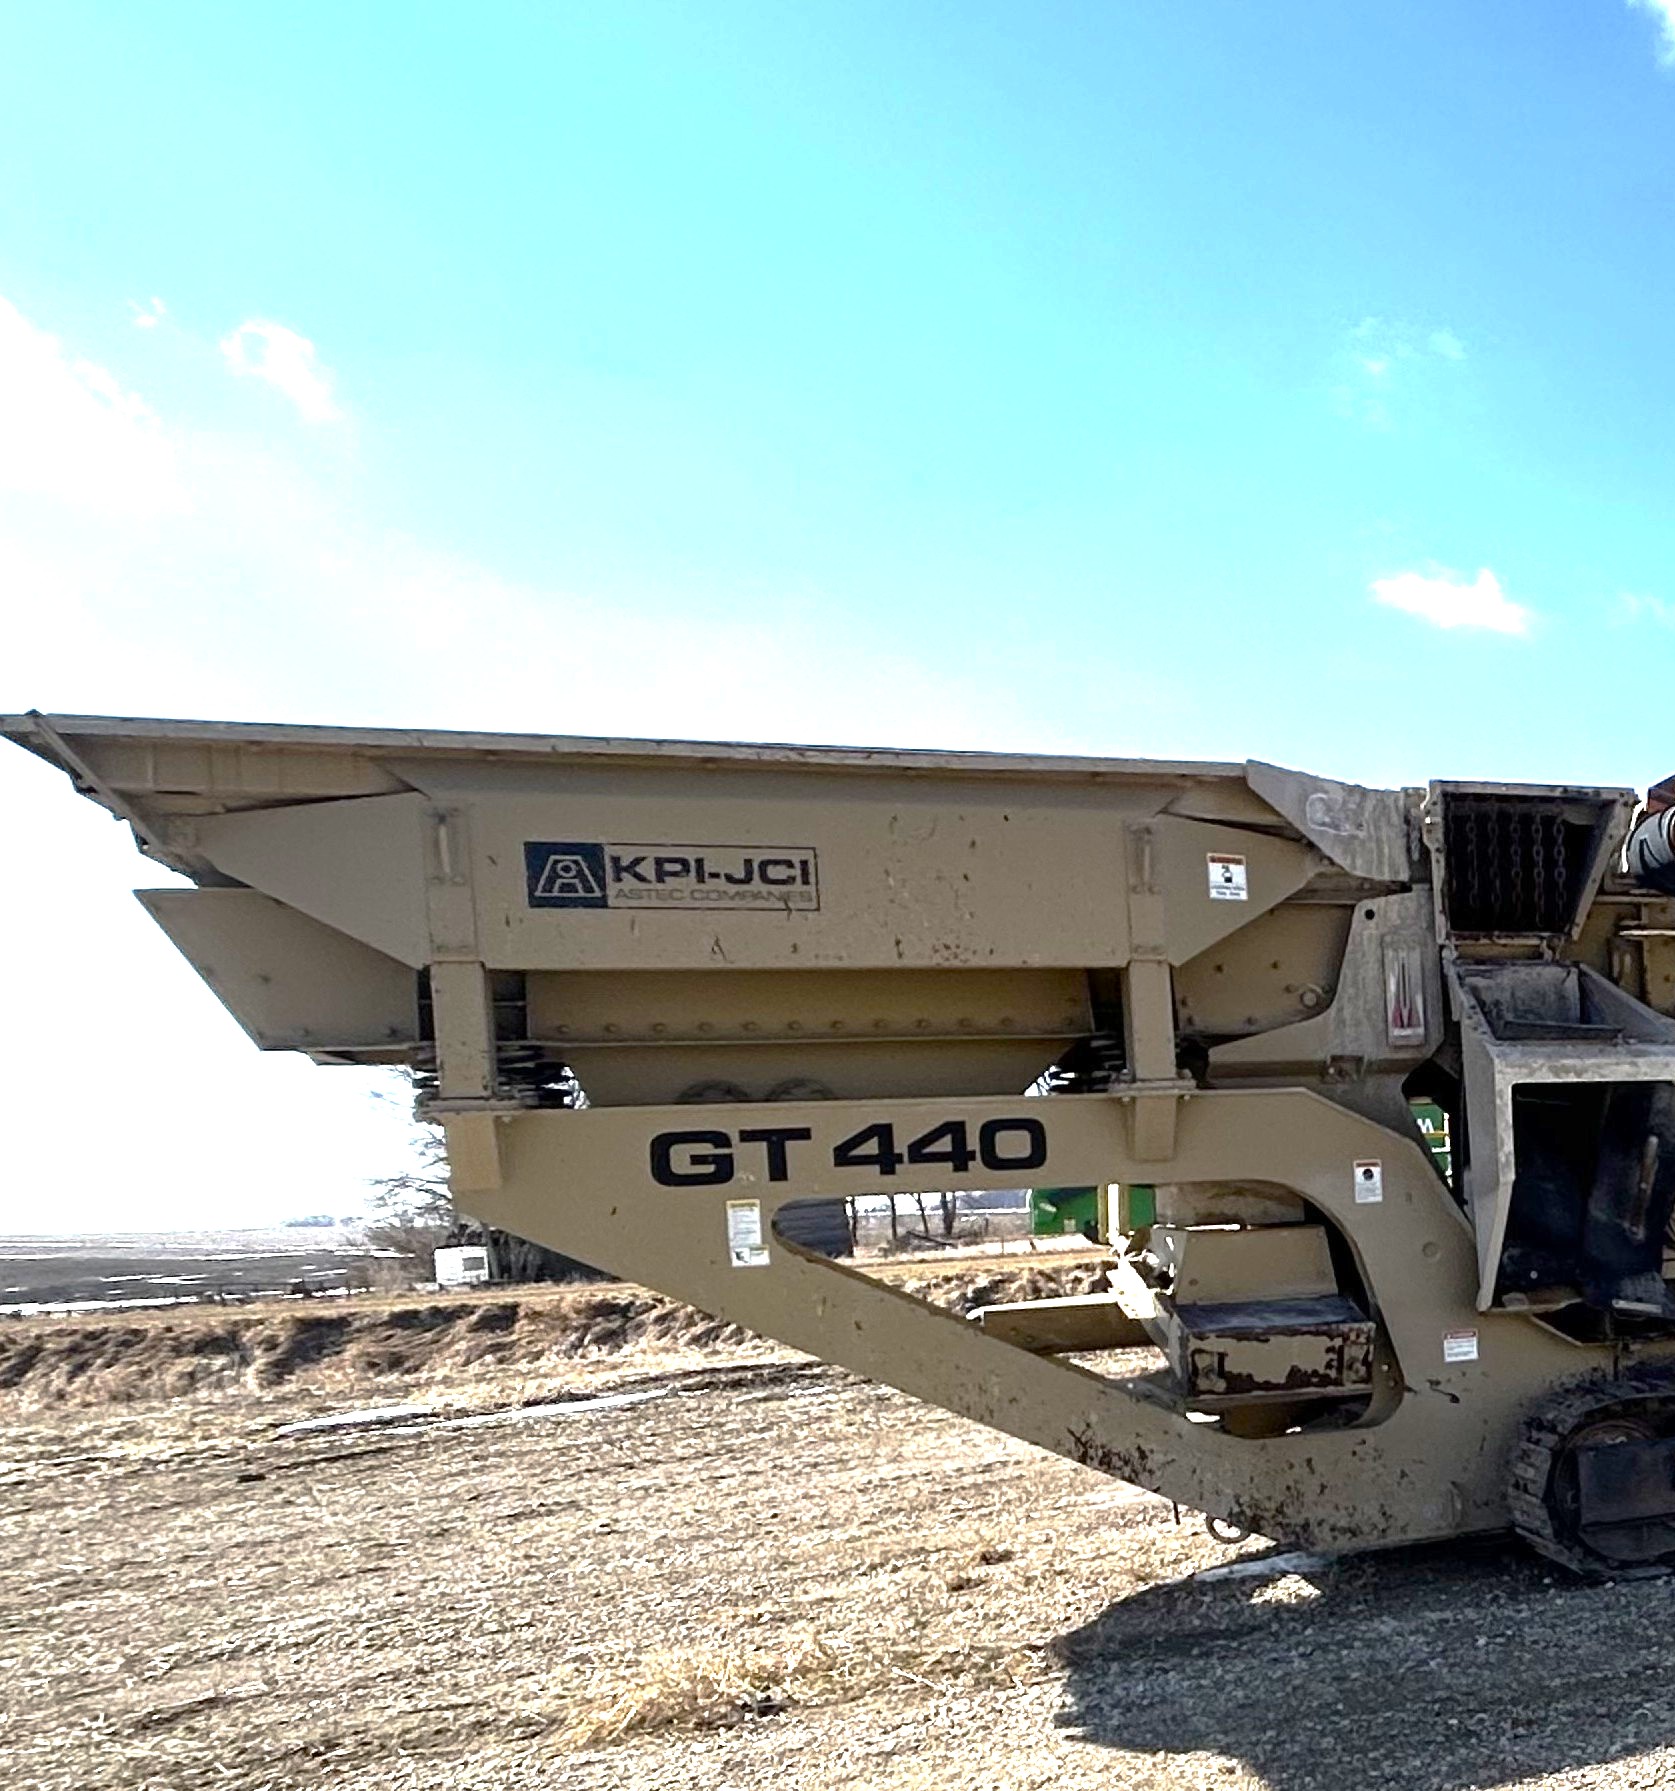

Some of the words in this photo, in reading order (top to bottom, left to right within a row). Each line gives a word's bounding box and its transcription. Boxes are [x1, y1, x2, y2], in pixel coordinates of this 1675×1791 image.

[610, 855, 811, 886] KPI-JCI
[614, 888, 684, 900] ASTEC
[690, 889, 812, 903] COMPANIES
[649, 1127, 812, 1187] GT
[833, 1118, 1047, 1175] 440
